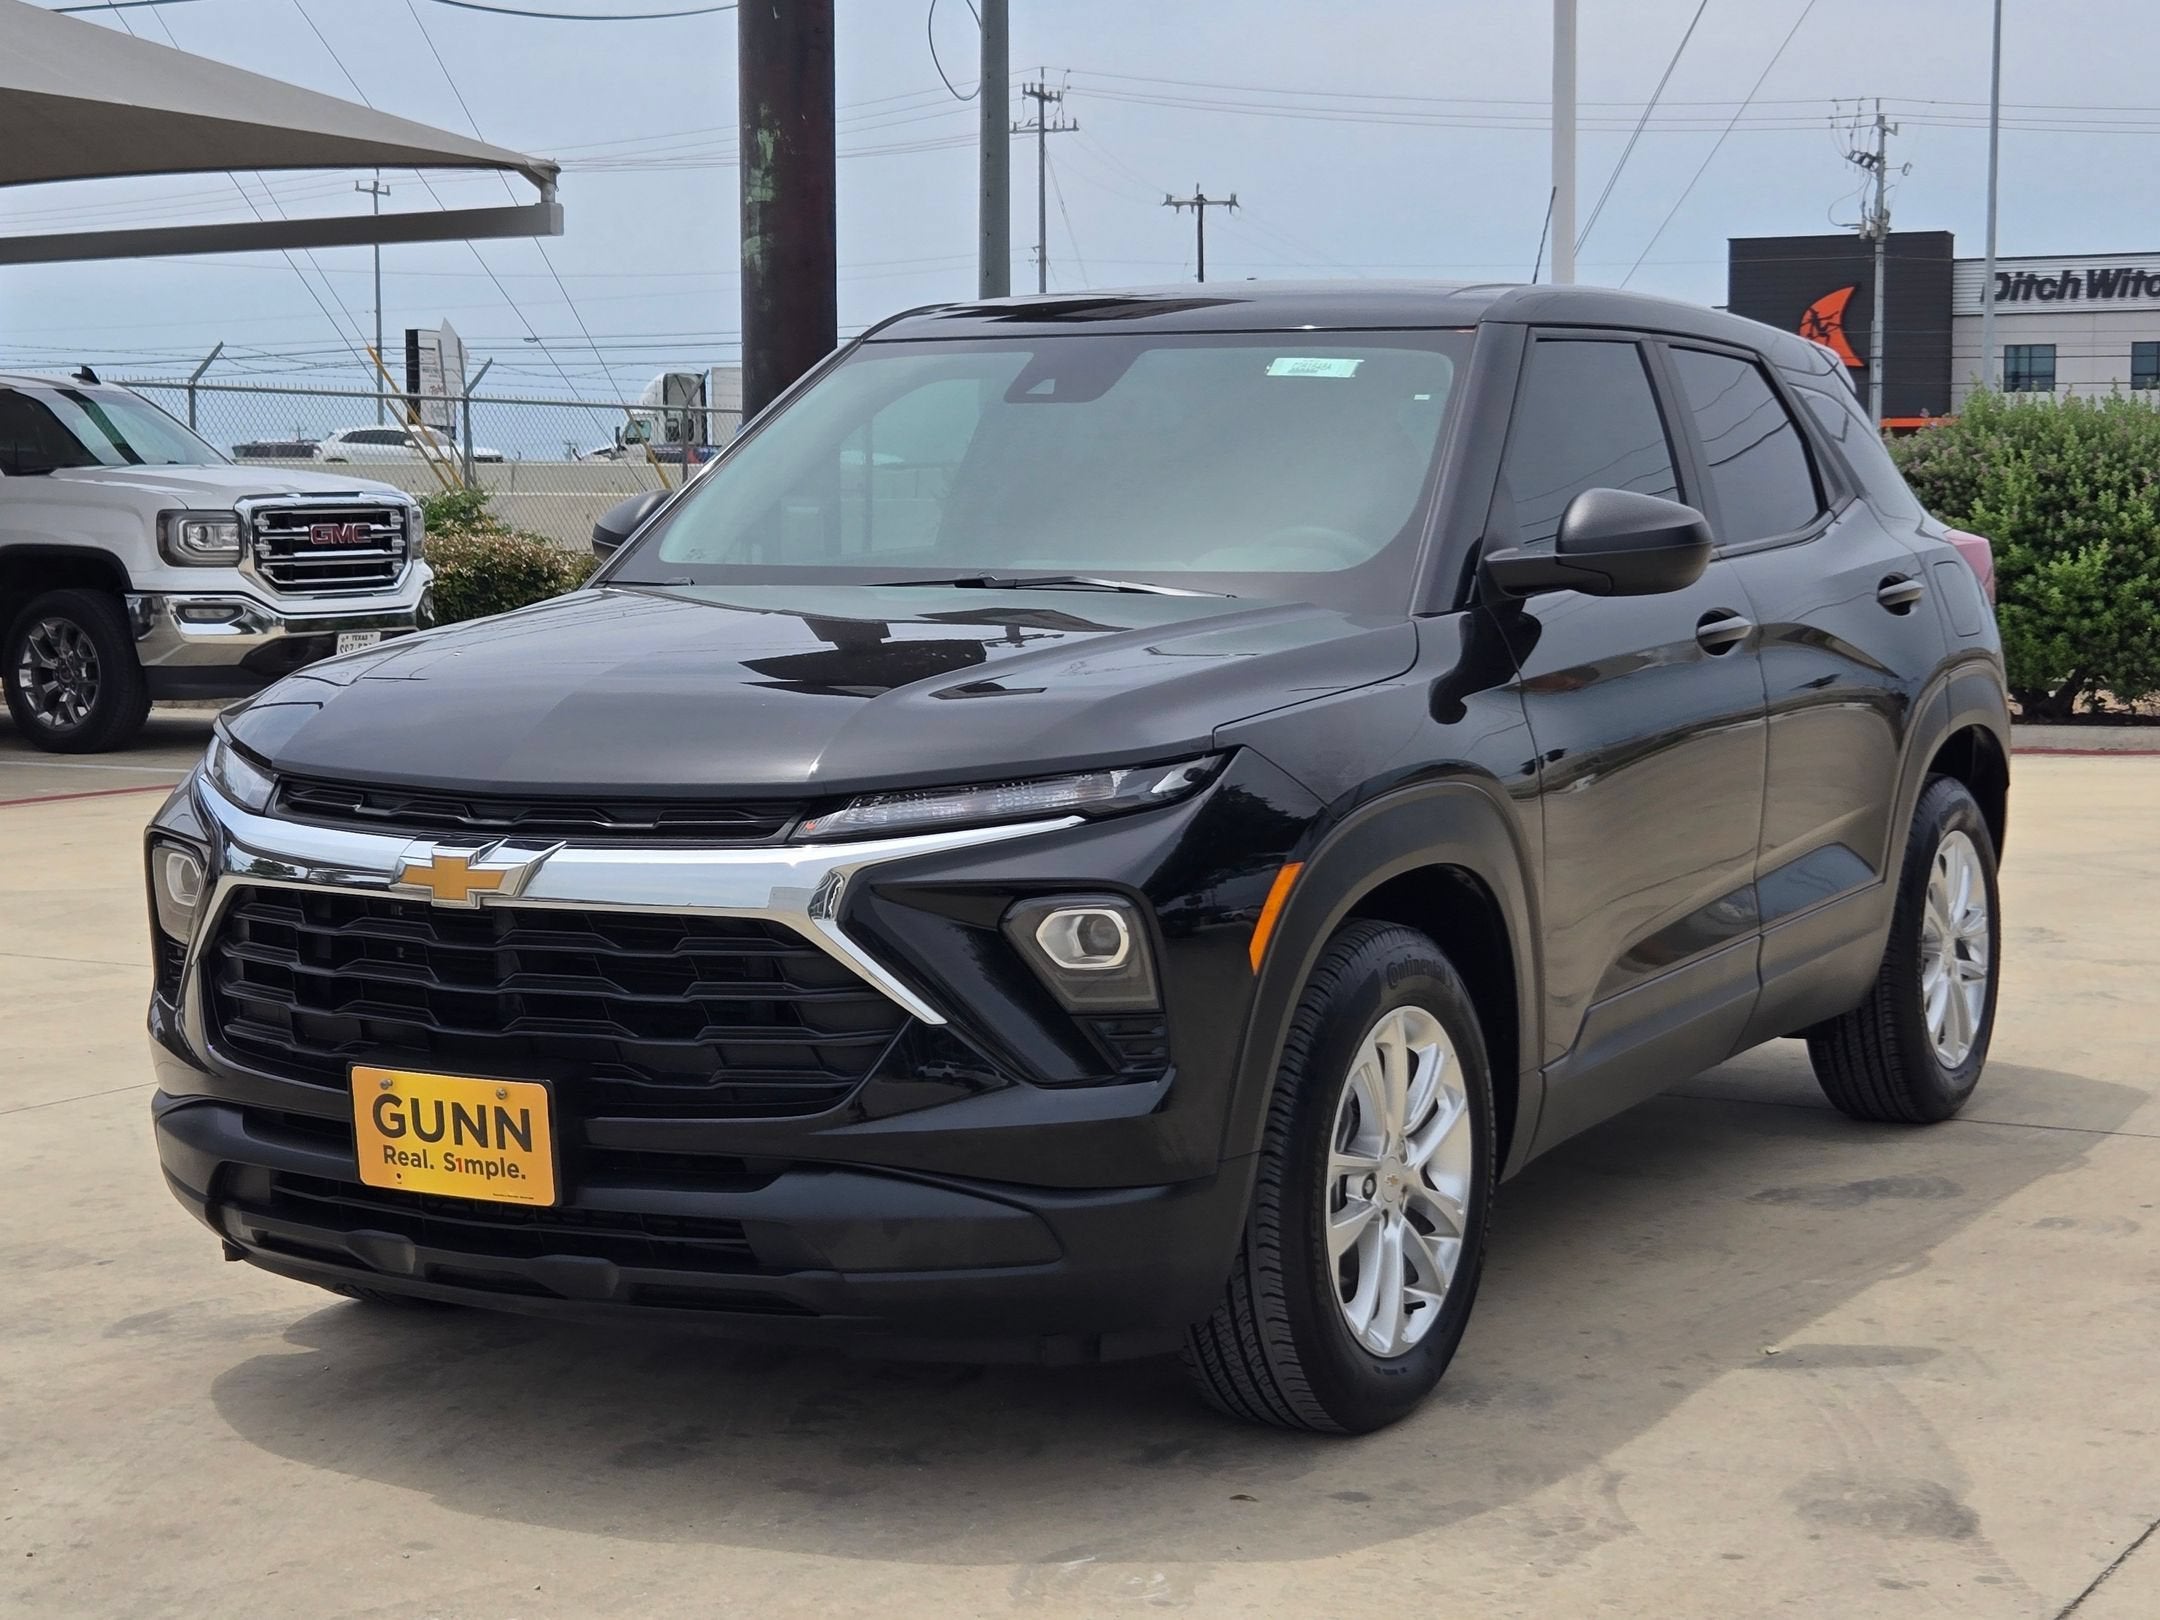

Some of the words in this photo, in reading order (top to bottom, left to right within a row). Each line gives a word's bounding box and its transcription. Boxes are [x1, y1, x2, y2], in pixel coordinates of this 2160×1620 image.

[1980, 269, 2082, 303] Ditch
[311, 523, 372, 545] GMC
[372, 1093, 532, 1152] GUNN
[383, 1144, 434, 1170] Real.
